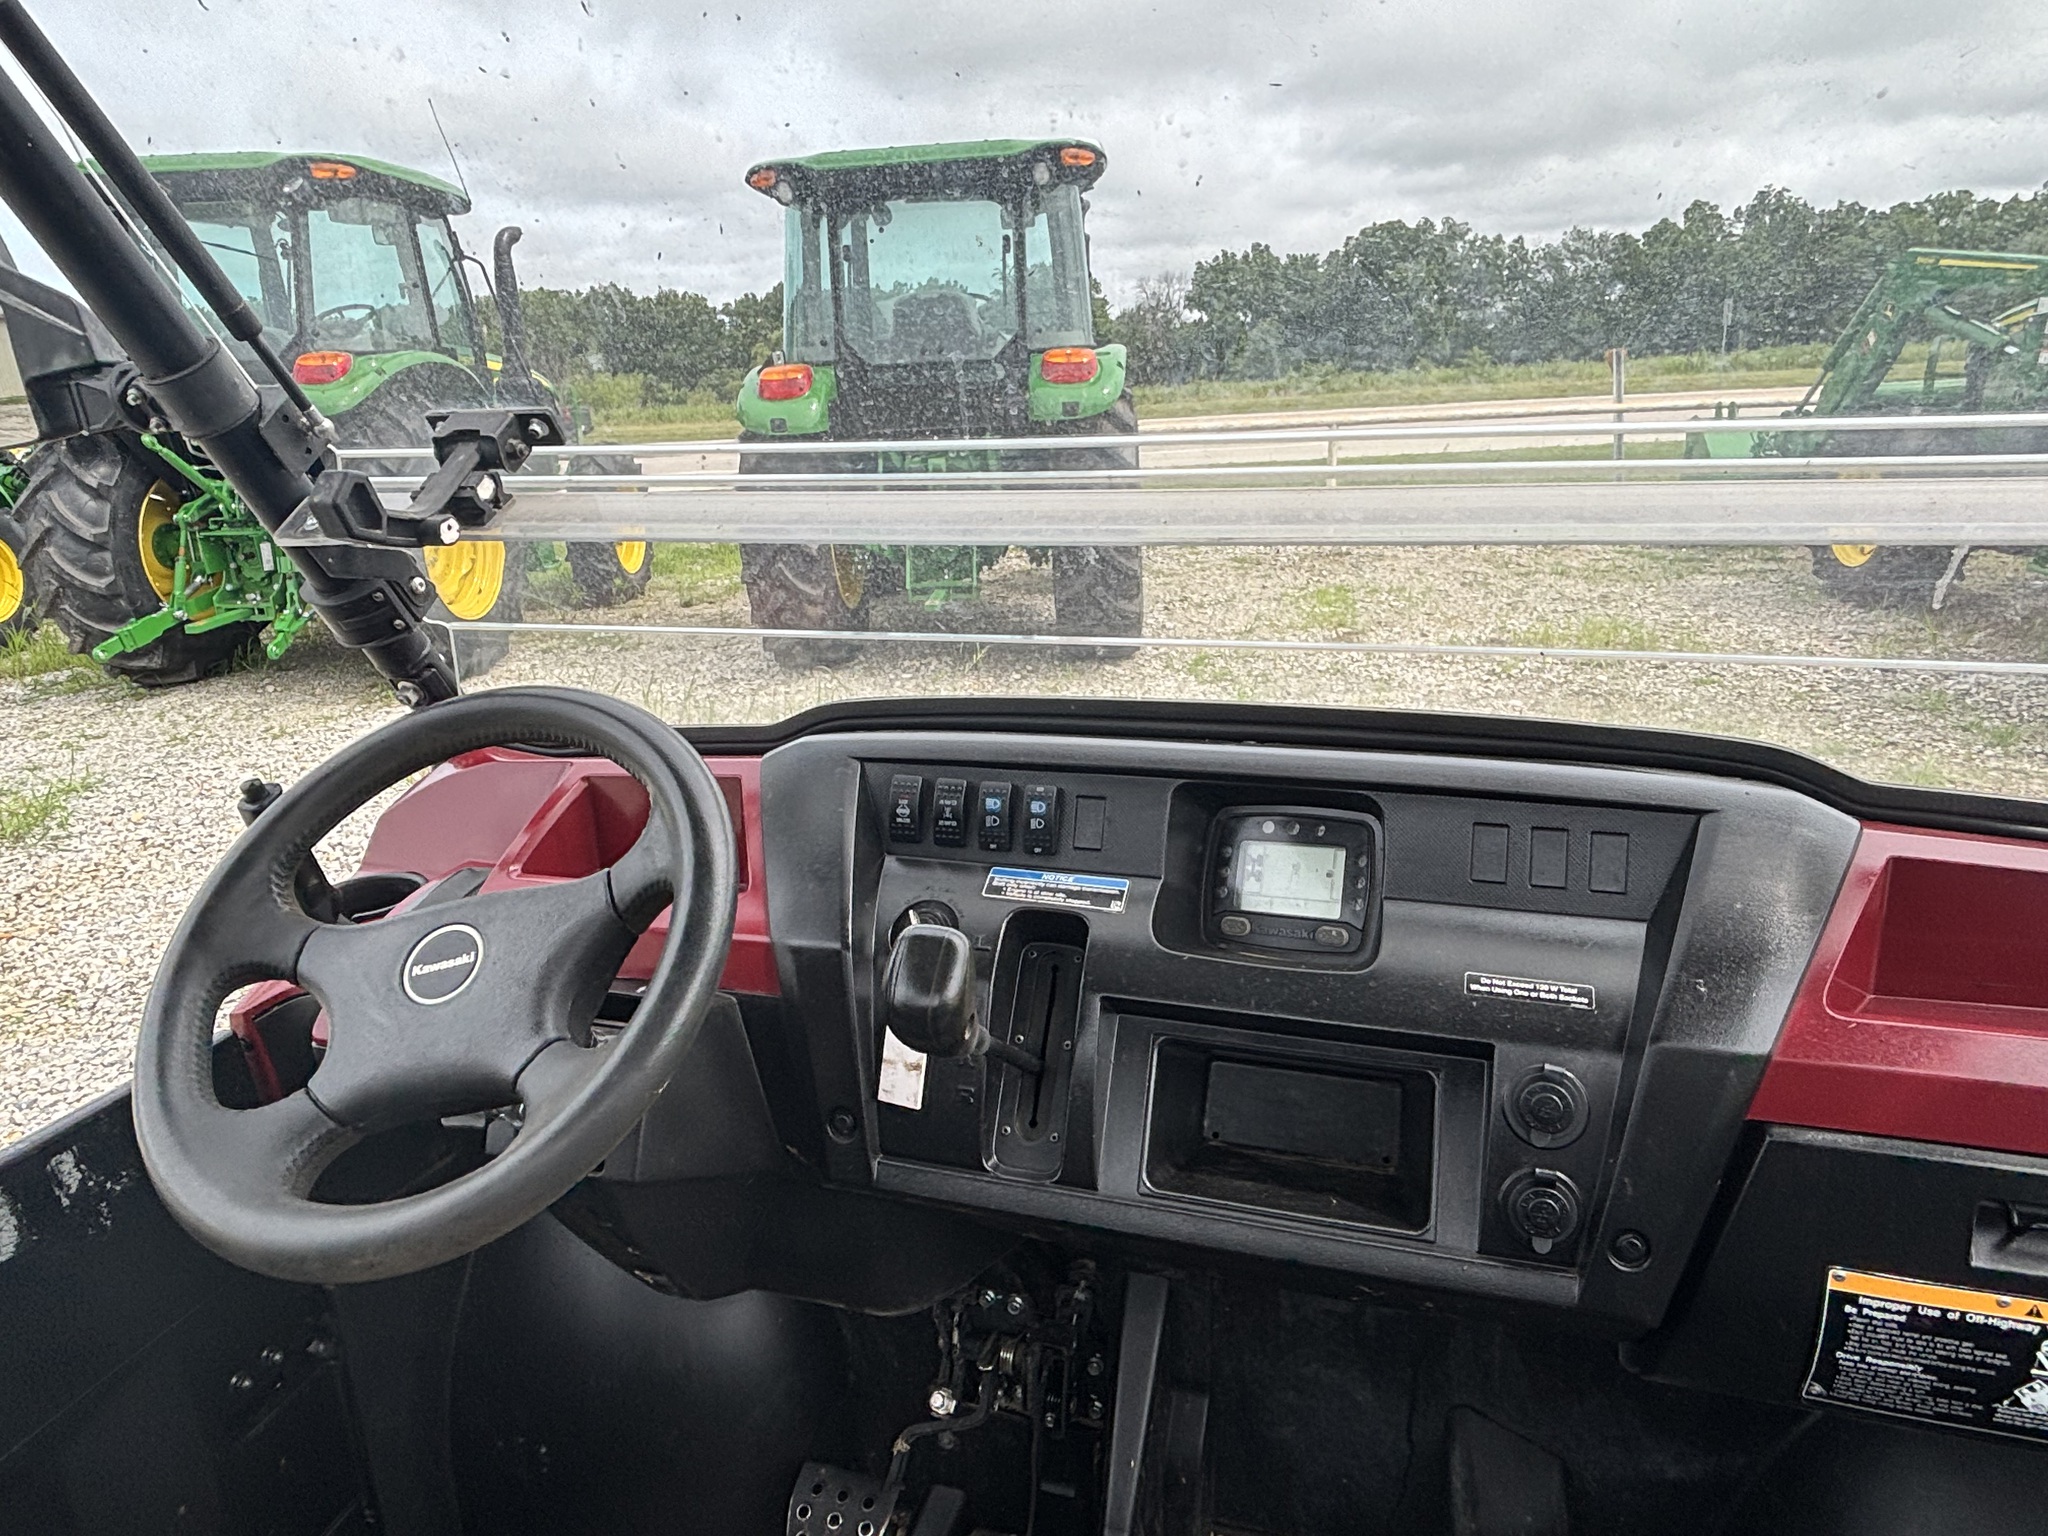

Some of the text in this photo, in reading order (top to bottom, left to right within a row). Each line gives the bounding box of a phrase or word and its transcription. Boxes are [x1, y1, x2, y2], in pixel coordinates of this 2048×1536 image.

[1041, 873, 1074, 883] NOTICE
[411, 951, 475, 977] Kawasaki
[1469, 983, 1490, 992] When
[1492, 986, 1512, 996] Using
[1513, 989, 1529, 997] One
[1539, 991, 1557, 1000] Both
[1492, 978, 1506, 986] Not
[1507, 980, 1534, 989] Exceed
[1559, 986, 1578, 994] Total
[1844, 1304, 1858, 1314] Be
[1862, 1307, 1907, 1323] Prepared
[1858, 1296, 2042, 1335] Improper Use of Off-Highway
[1835, 1351, 1860, 1362] Drive
